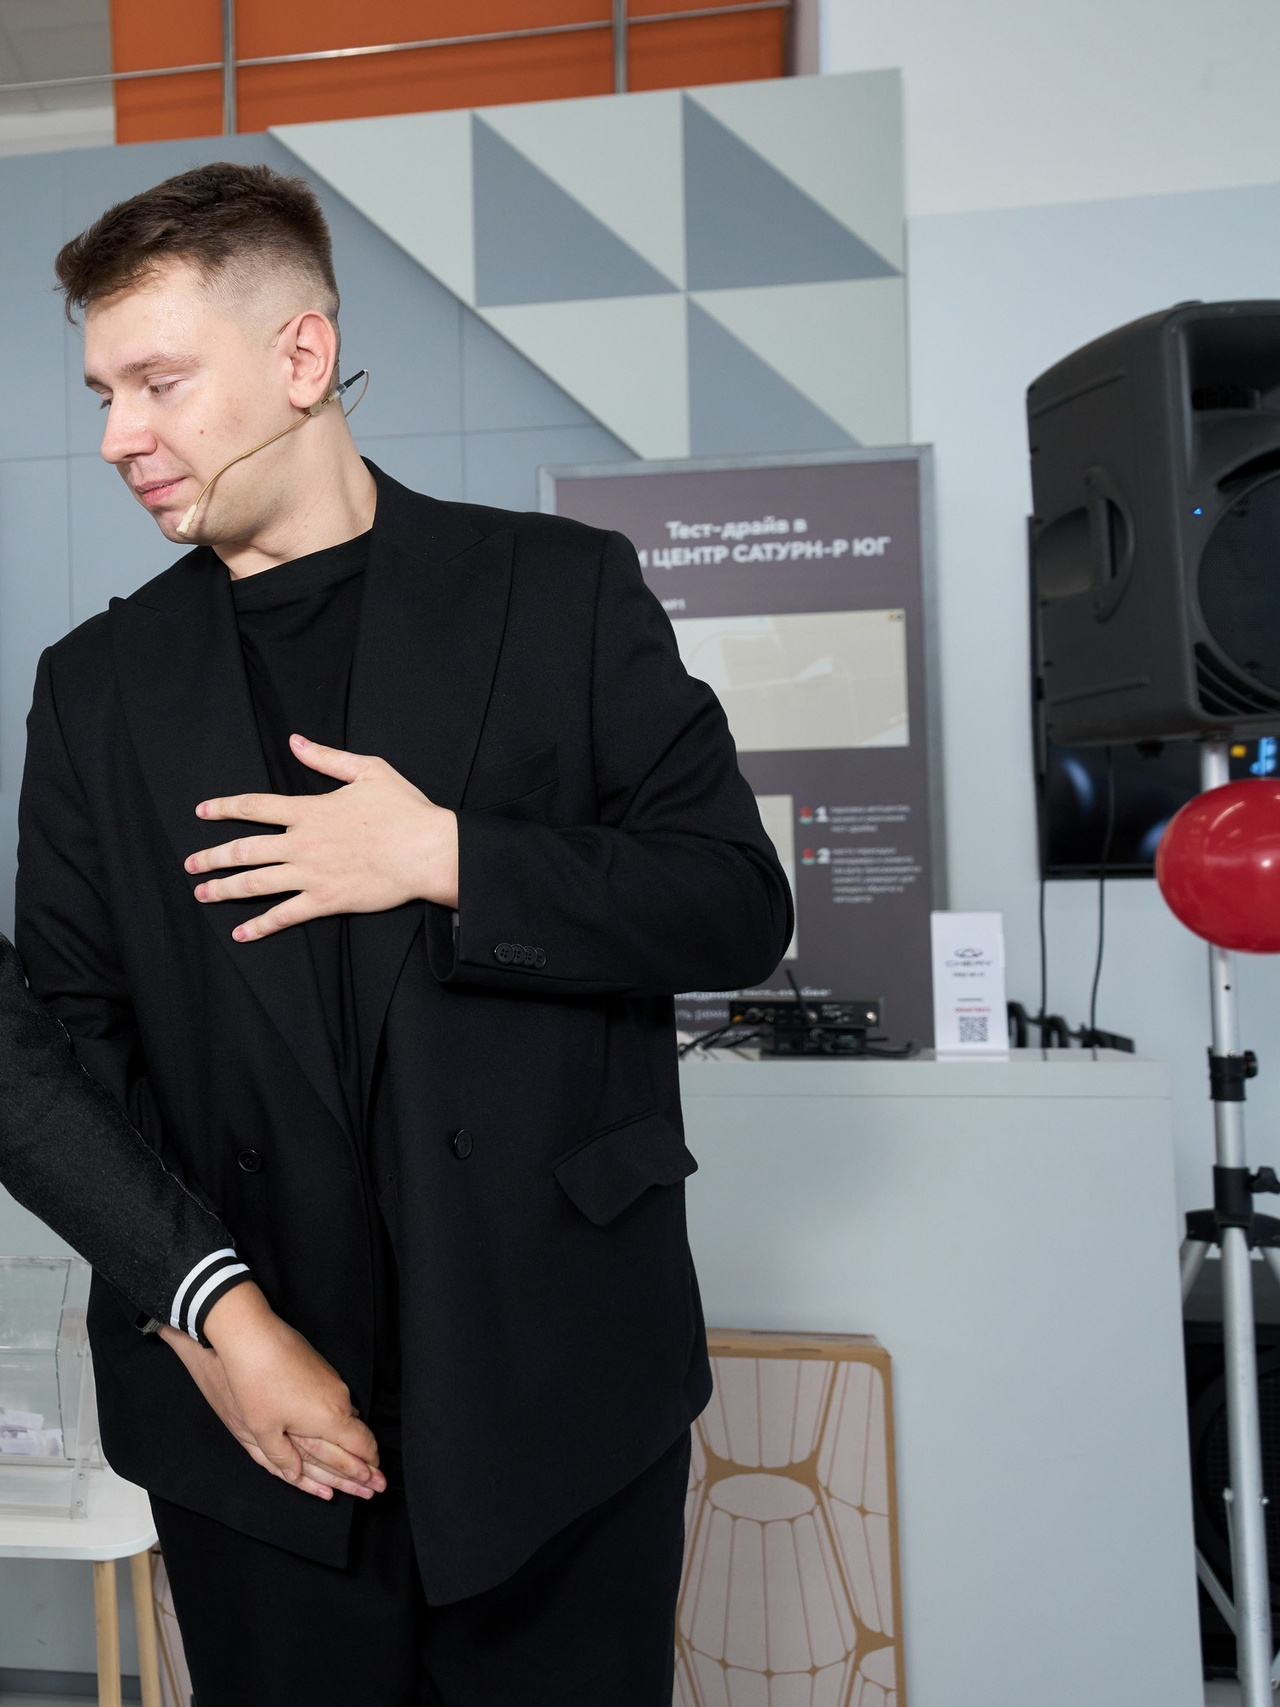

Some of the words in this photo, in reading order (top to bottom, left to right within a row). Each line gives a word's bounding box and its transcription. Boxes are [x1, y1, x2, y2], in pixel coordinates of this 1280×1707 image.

[666, 515, 790, 540] Тест-драйв
[652, 545, 729, 569] ЦЕНТР
[732, 539, 849, 563] САТУРН-Р
[852, 536, 892, 557] ЮГ
[815, 806, 829, 823] 1
[817, 847, 831, 864] 2
